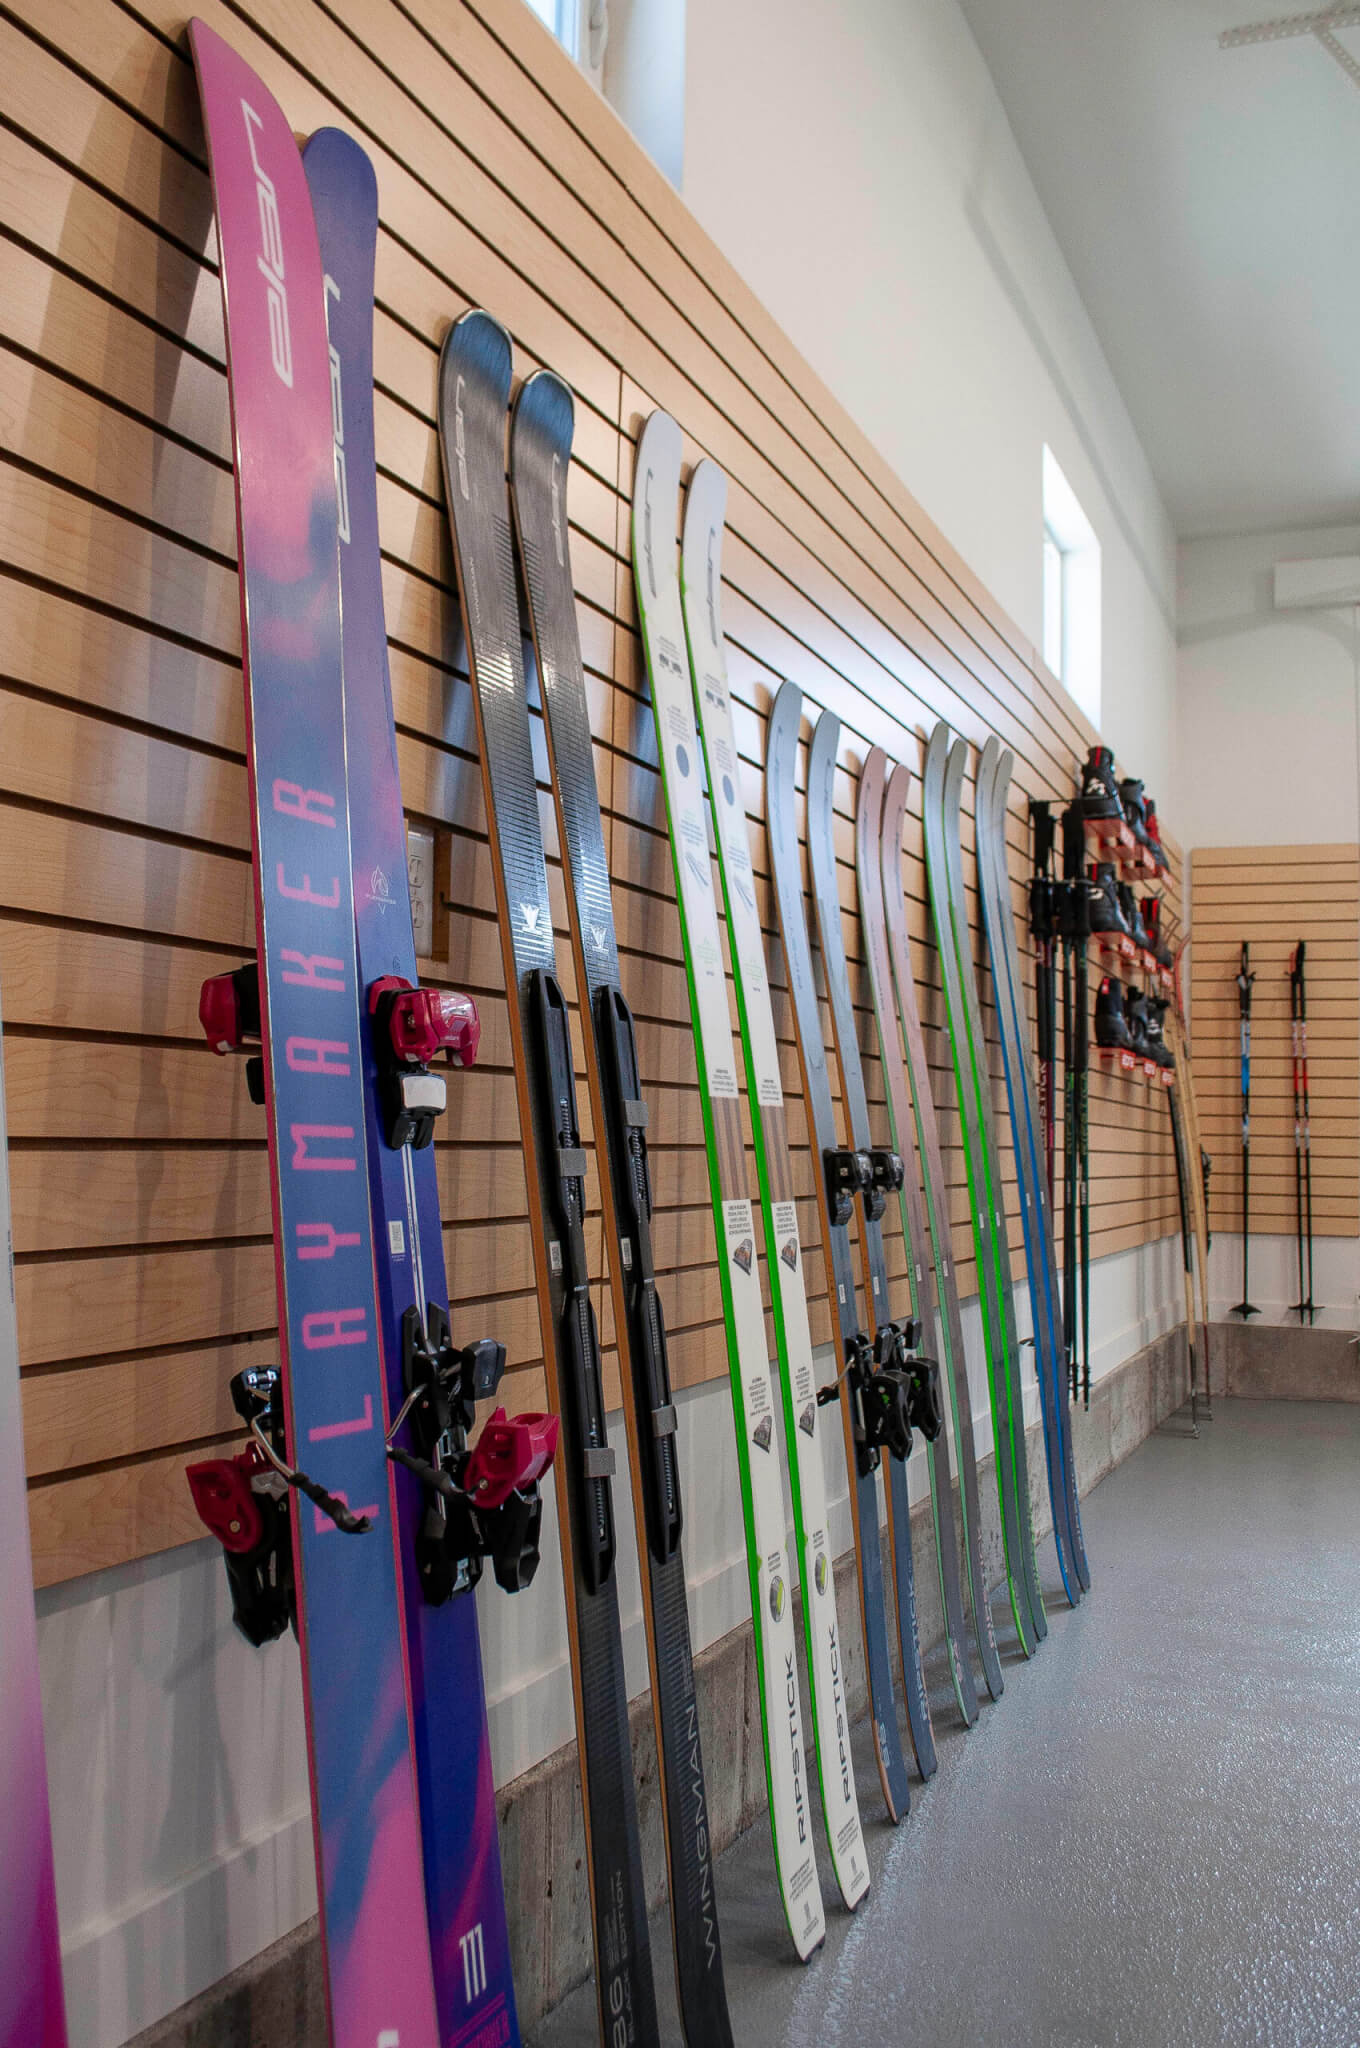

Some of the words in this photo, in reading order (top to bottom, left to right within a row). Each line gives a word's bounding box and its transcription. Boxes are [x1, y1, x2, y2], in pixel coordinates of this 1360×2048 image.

[784, 1650, 807, 1845] RIPSTICK
[828, 1622, 851, 1803] RIPSTICK
[685, 1703, 716, 1969] WINGMAN
[616, 1870, 628, 1960] EDITION
[609, 1975, 628, 2048] 86
[623, 1967, 636, 2044] BLACK
